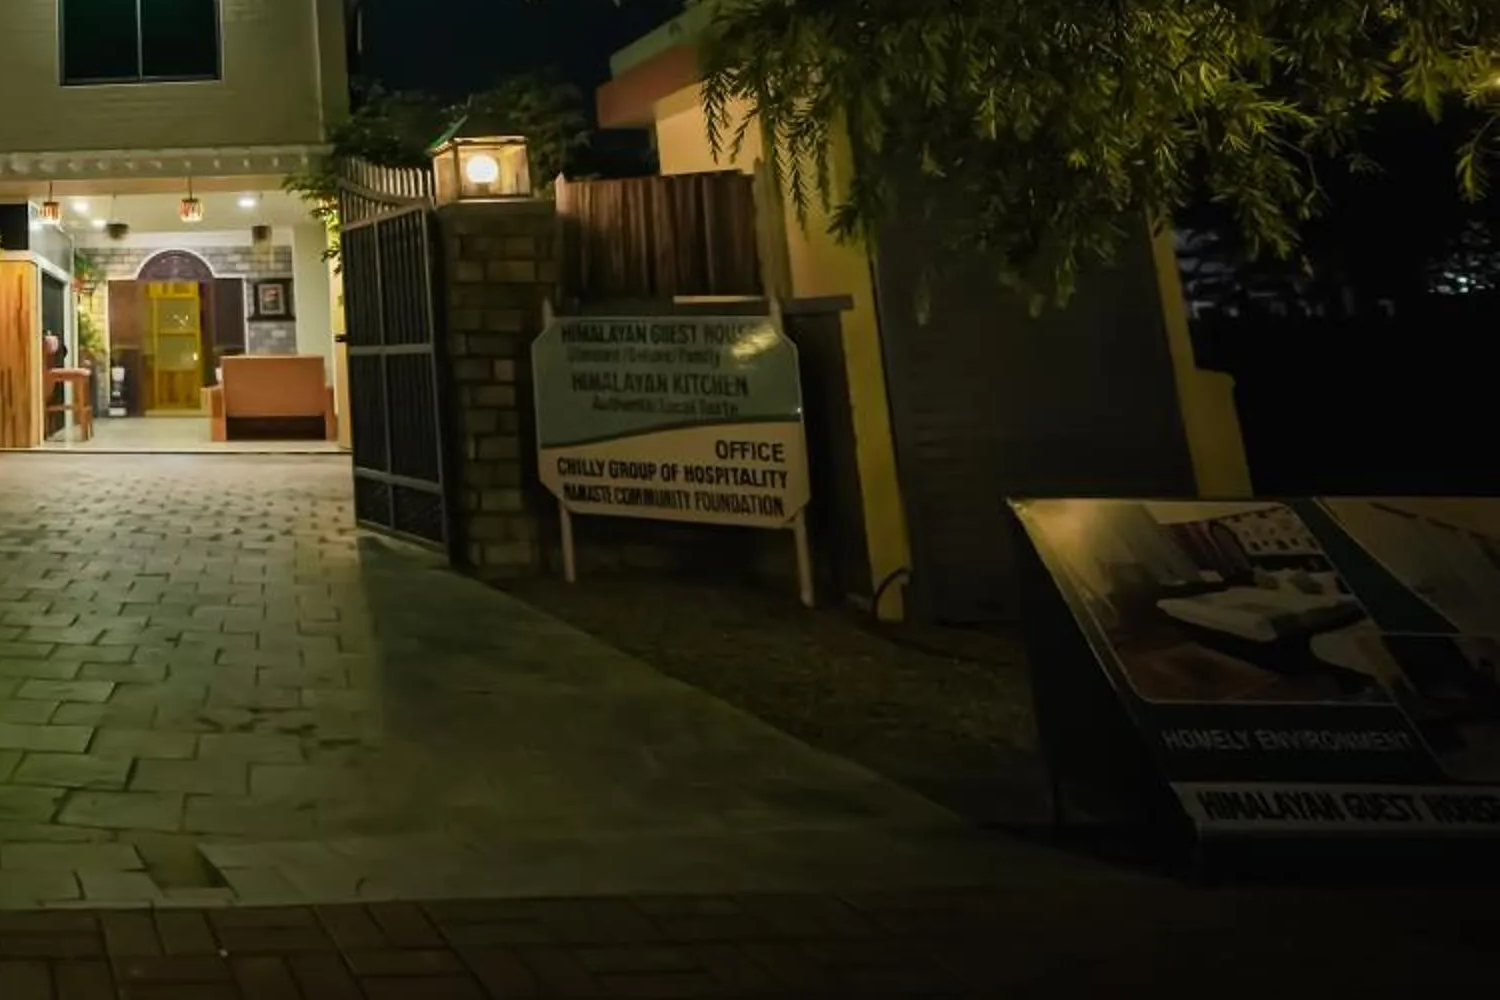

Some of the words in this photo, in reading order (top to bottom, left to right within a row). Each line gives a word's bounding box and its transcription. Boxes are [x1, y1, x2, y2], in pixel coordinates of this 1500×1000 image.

[562, 324, 647, 344] HIMALAYAN
[650, 325, 697, 344] GUEST
[702, 325, 756, 345] HOUS
[572, 372, 667, 393] HIMALAYAN
[672, 373, 749, 397] KITCHEN
[714, 440, 787, 463] OFFICE
[556, 457, 606, 478] CHILLY
[608, 461, 657, 480] GROUP
[660, 463, 679, 481] OF
[683, 464, 788, 488] HOSPITALITY
[613, 486, 689, 507] COMMUNITY
[693, 489, 784, 517] FOUNDATION
[1158, 727, 1251, 751] HOMELY
[1253, 728, 1414, 752] ENVIRONMENT
[1197, 790, 1345, 820] HIMALAYAN
[1342, 793, 1422, 822] GUEST
